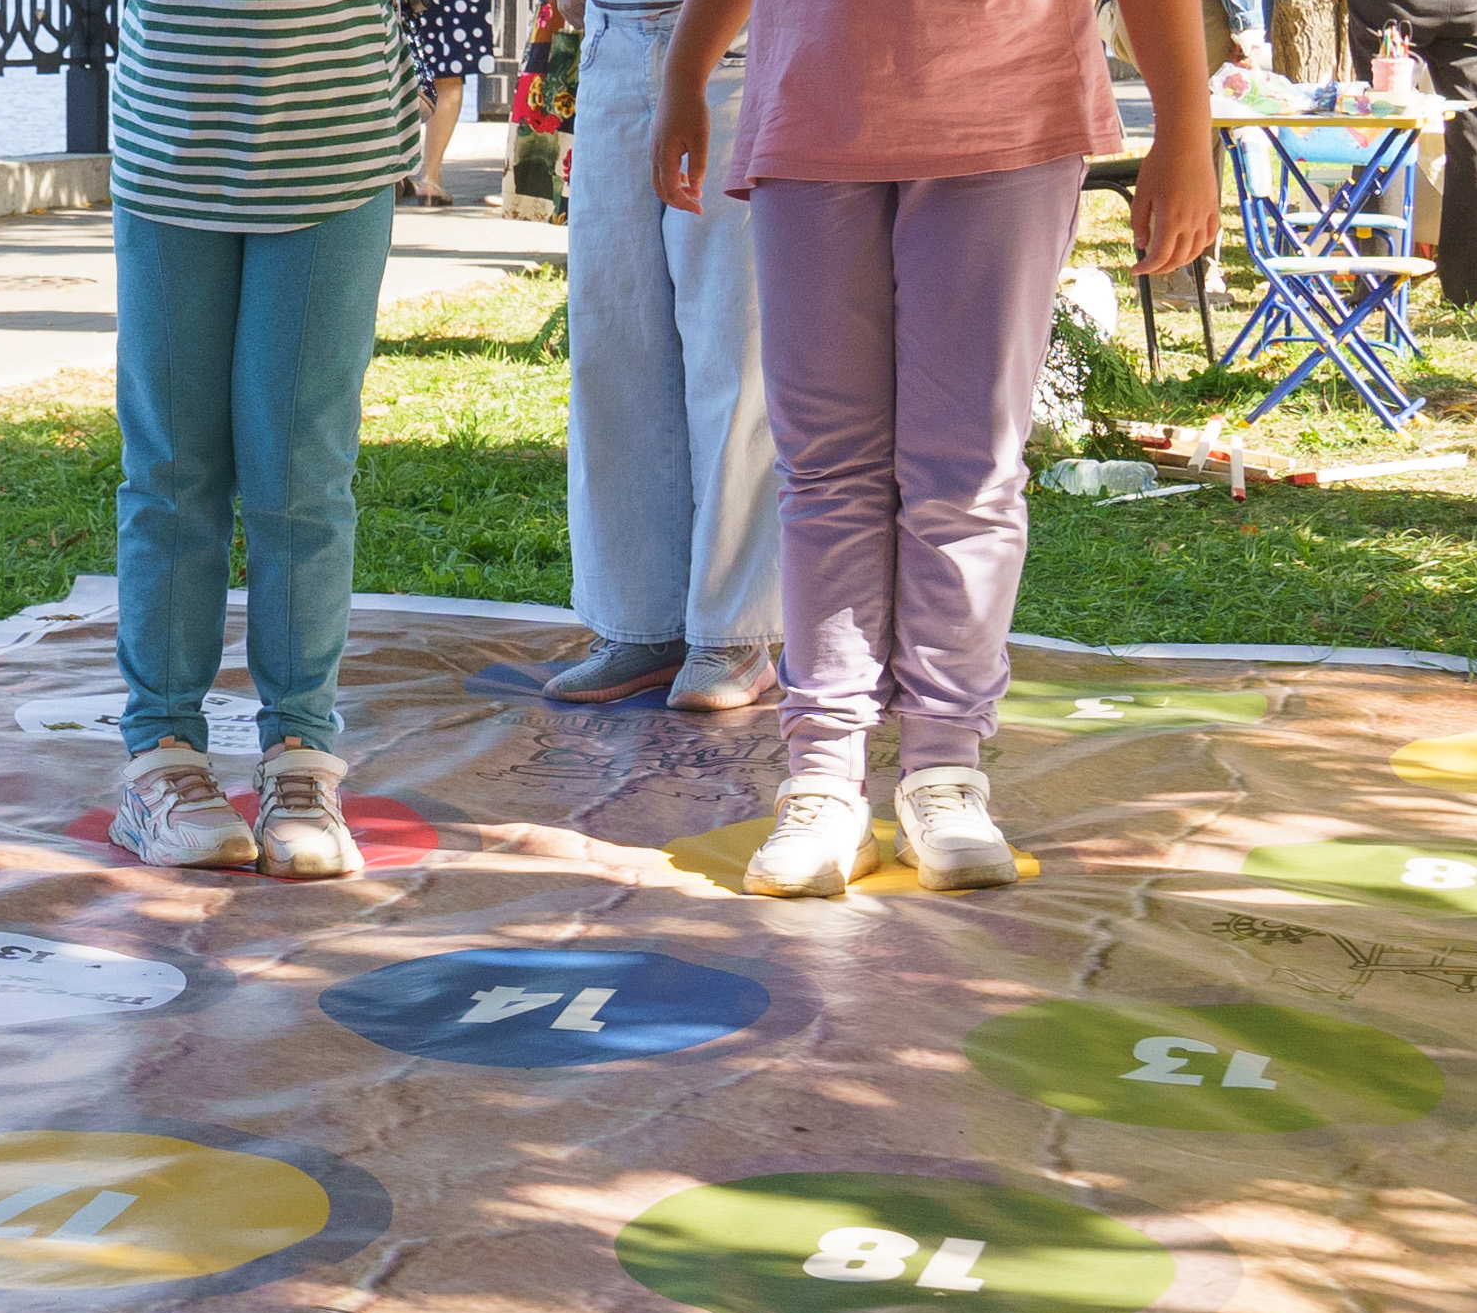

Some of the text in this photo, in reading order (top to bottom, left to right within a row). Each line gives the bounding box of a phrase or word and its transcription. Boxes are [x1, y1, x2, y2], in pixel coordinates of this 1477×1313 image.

[1063, 695, 1135, 719] 3
[1400, 856, 1477, 889] 8
[457, 985, 617, 1033] 14
[1119, 1036, 1278, 1090] 13
[802, 1226, 986, 1293] 18
